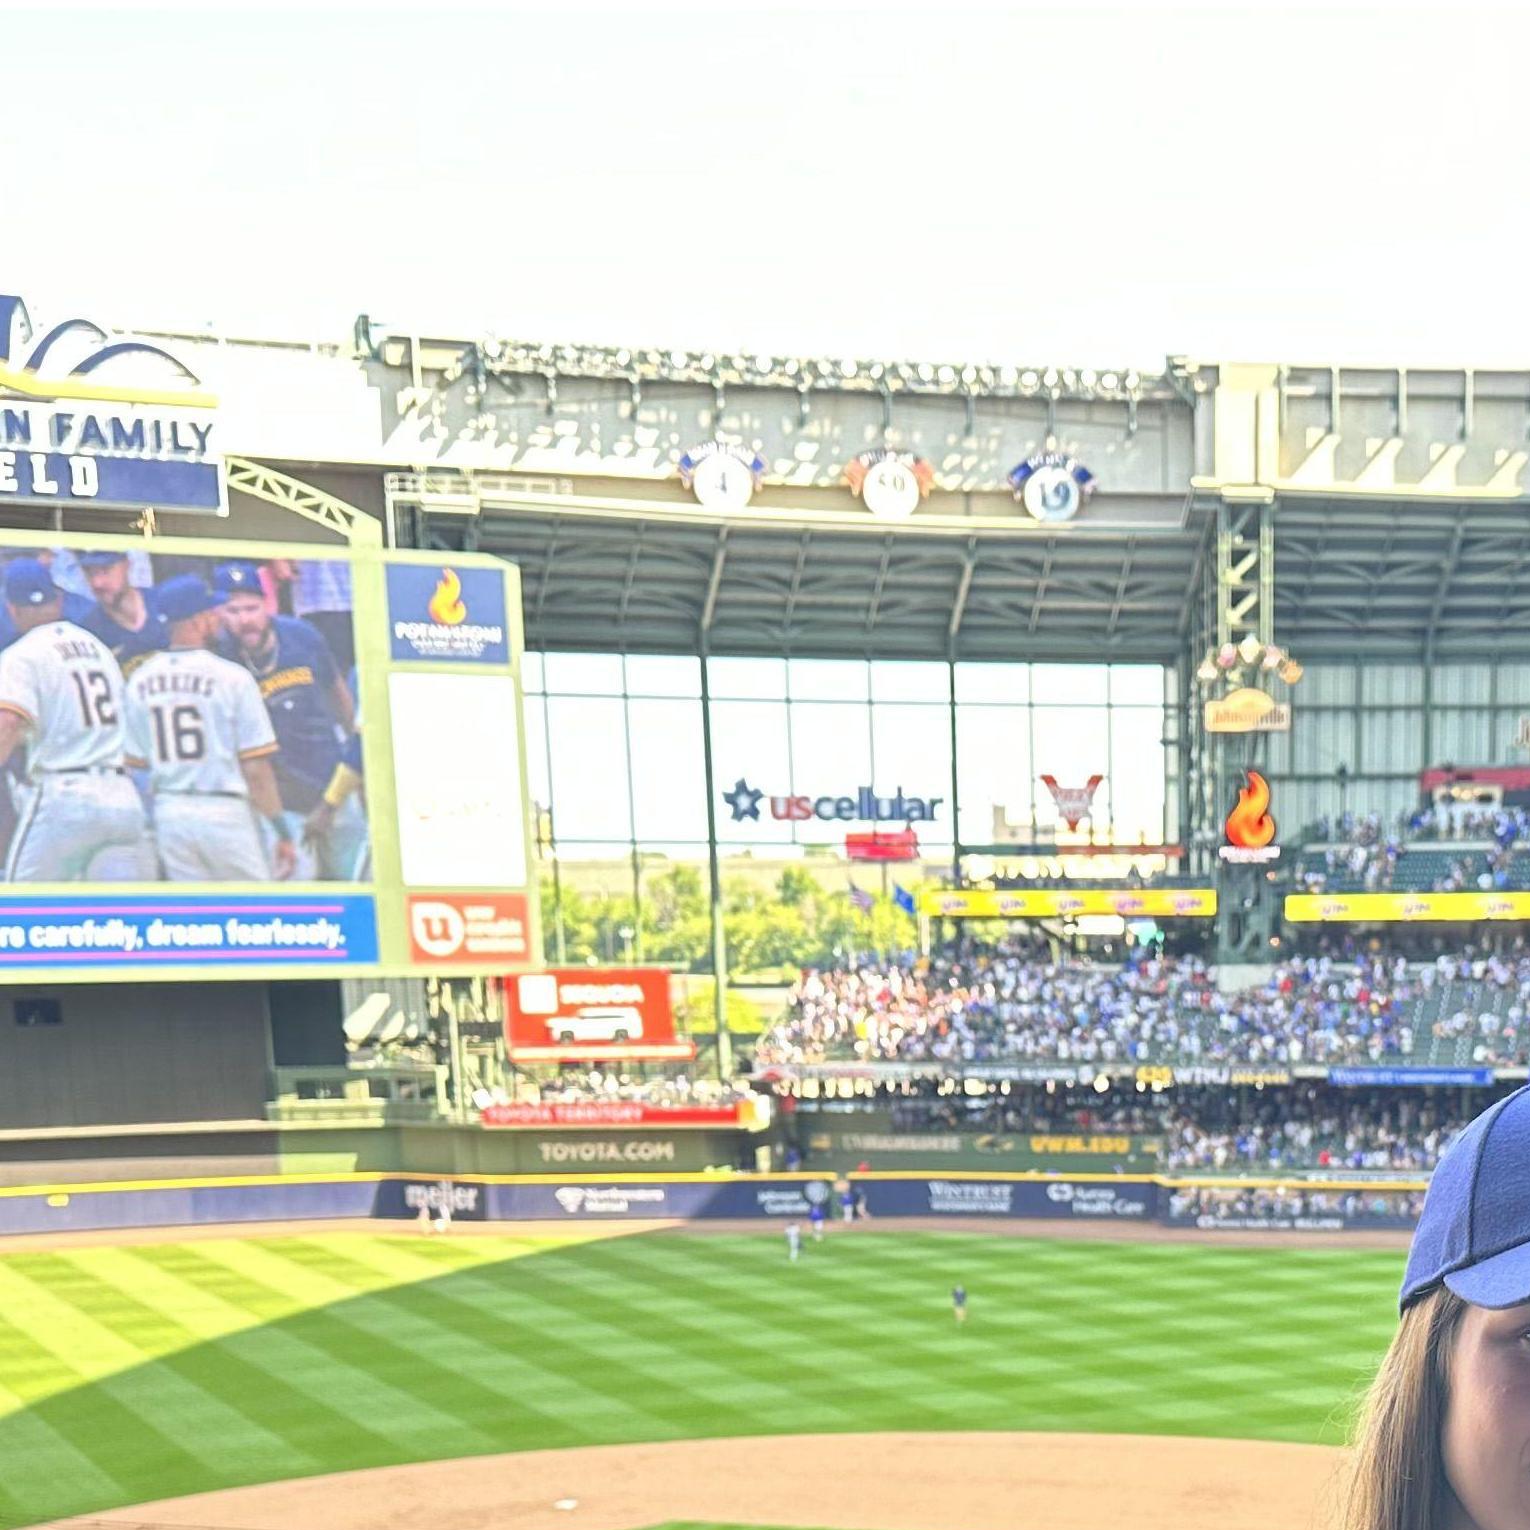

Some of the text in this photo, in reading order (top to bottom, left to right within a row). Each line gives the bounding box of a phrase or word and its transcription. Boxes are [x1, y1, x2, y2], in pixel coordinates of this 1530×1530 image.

[50, 412, 213, 453] FAMILY
[0, 451, 98, 497] ELD
[71, 670, 117, 727] 12
[150, 705, 206, 762] 16
[769, 786, 944, 822] uscellular
[539, 1141, 675, 1163] TOYOTA.COM
